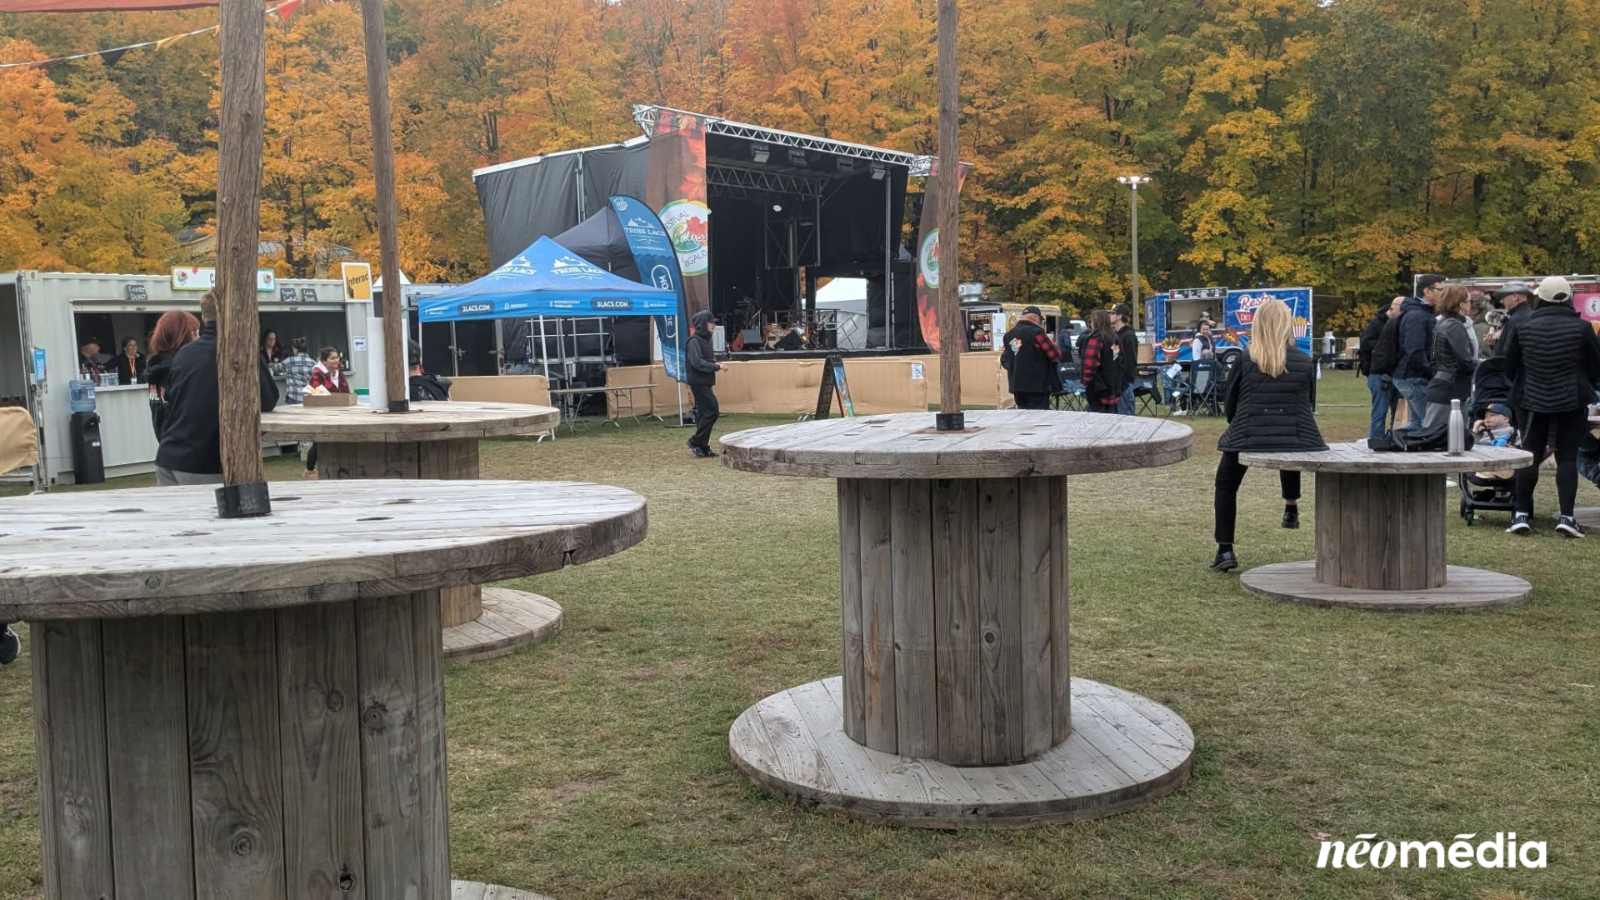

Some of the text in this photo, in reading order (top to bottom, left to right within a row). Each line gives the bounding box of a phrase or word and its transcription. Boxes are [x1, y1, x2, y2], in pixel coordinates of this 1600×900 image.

[624, 227, 647, 235] TROIS
[550, 266, 582, 275] TROIS
[462, 303, 491, 313] 3LACS.COM
[596, 300, 629, 308] 3LACS.COM
